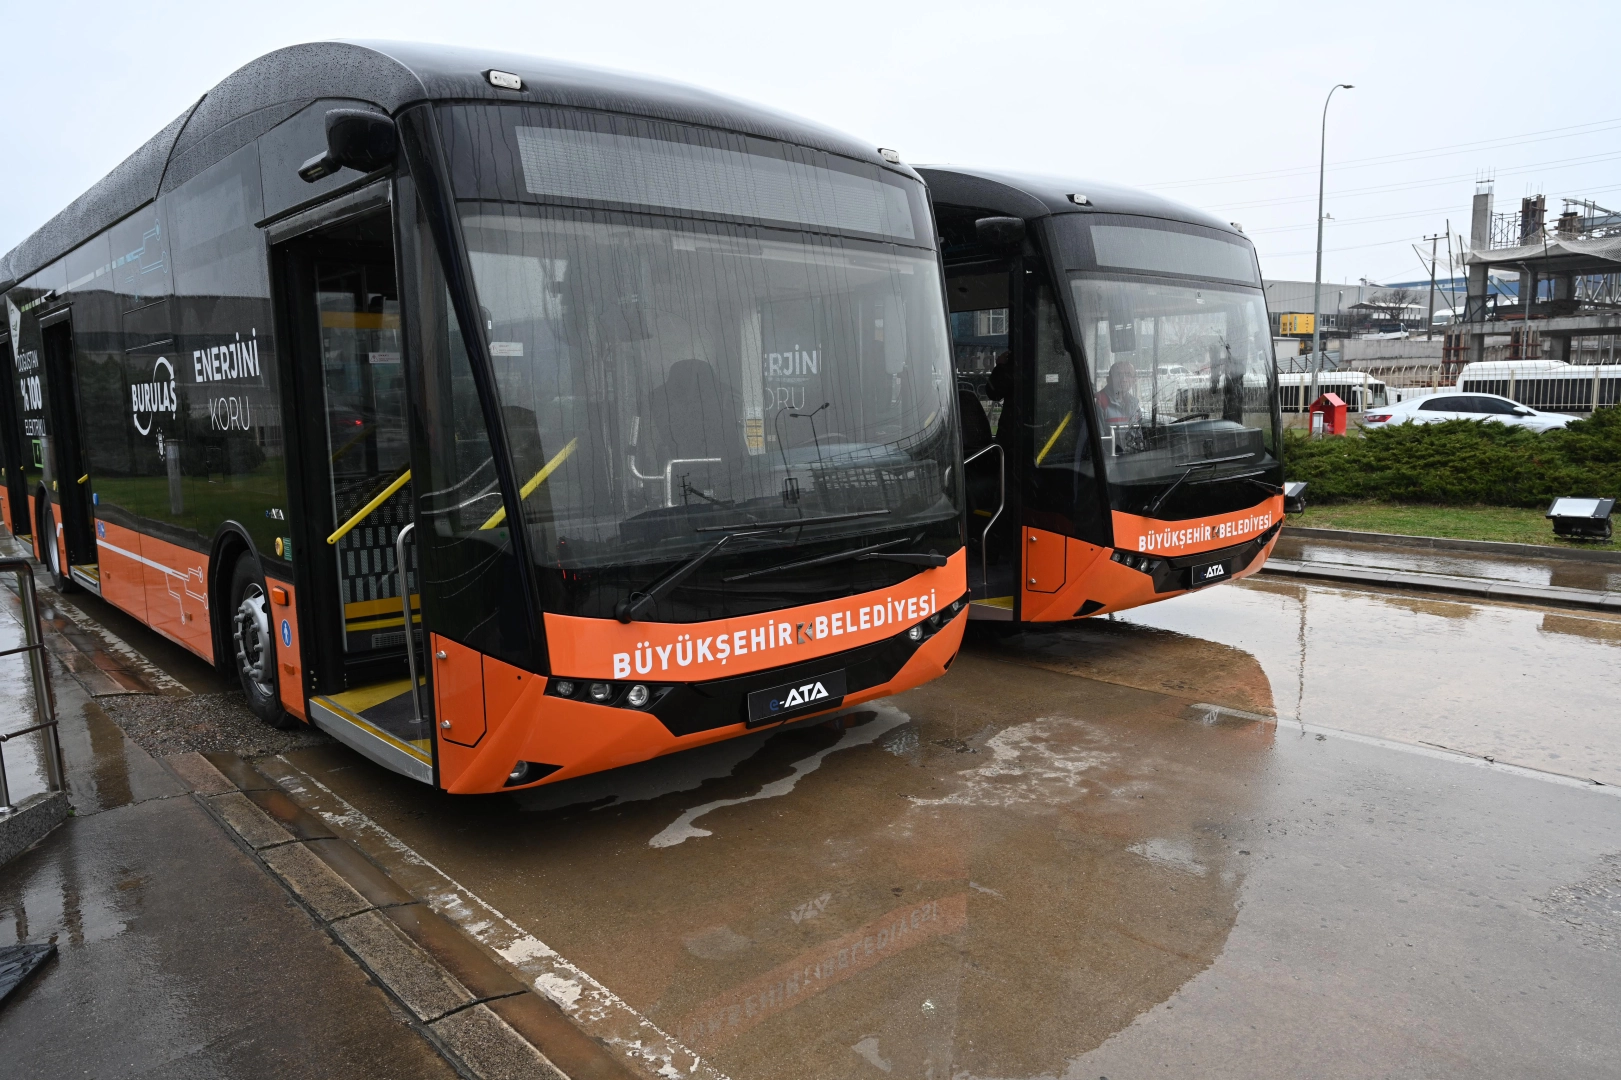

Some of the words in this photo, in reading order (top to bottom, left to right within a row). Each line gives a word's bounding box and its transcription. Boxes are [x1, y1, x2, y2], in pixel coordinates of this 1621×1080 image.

[193, 327, 260, 383] ENERJİNİ
[20, 375, 43, 411] %100
[131, 380, 177, 420] BURULAŞ
[209, 396, 250, 430] KORU
[1138, 523, 1211, 552] BÜYÜKŞEHİR
[1219, 511, 1273, 539] BELEDİYESİ
[612, 618, 793, 680] BÜYÜKŞEHİR
[814, 588, 936, 640] BELEDİYESİ
[769, 681, 830, 711] e-ATA
